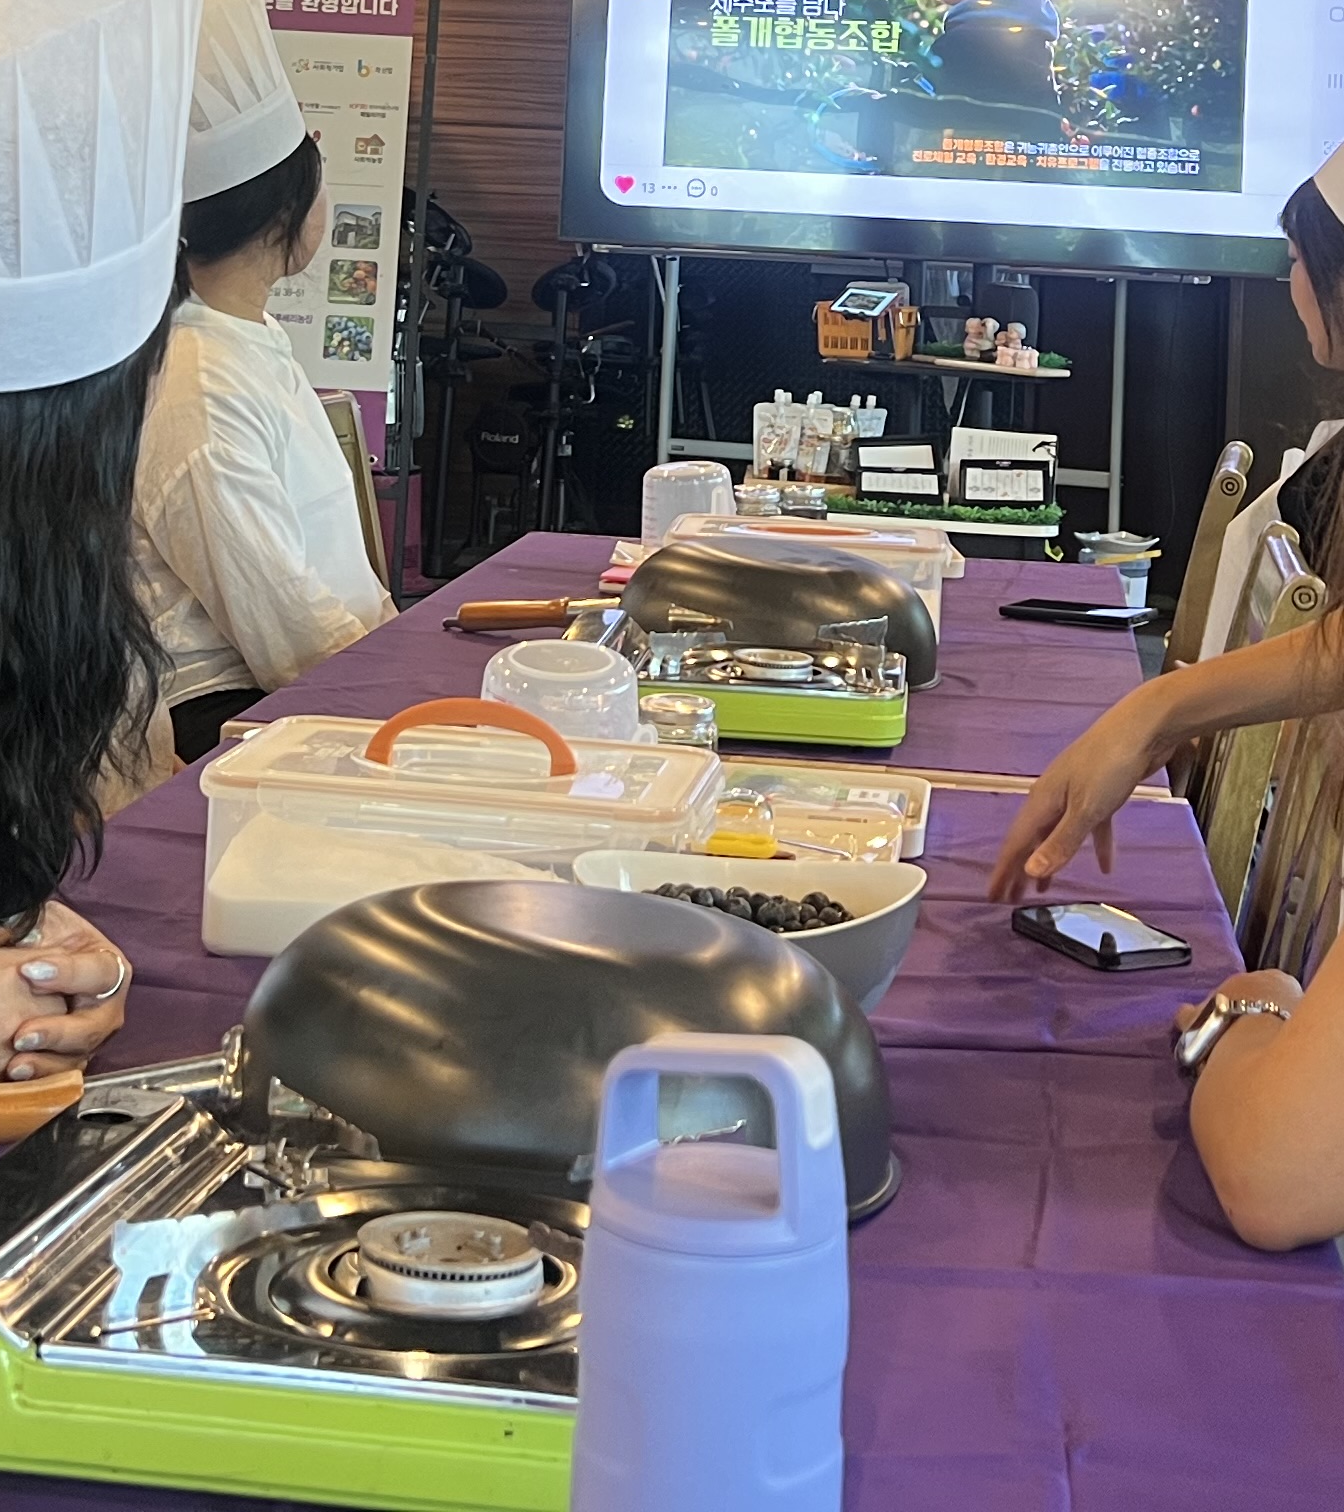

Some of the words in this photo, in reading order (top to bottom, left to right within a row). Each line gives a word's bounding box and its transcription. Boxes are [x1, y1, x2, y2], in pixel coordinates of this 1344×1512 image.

[710, 14, 903, 54] 폴개협동조합
[1091, 144, 1135, 159] 이루어진
[1156, 161, 1200, 175] 있습니다
[641, 182, 656, 194] 13
[710, 185, 719, 197] 0
[481, 431, 519, 444] Roland
